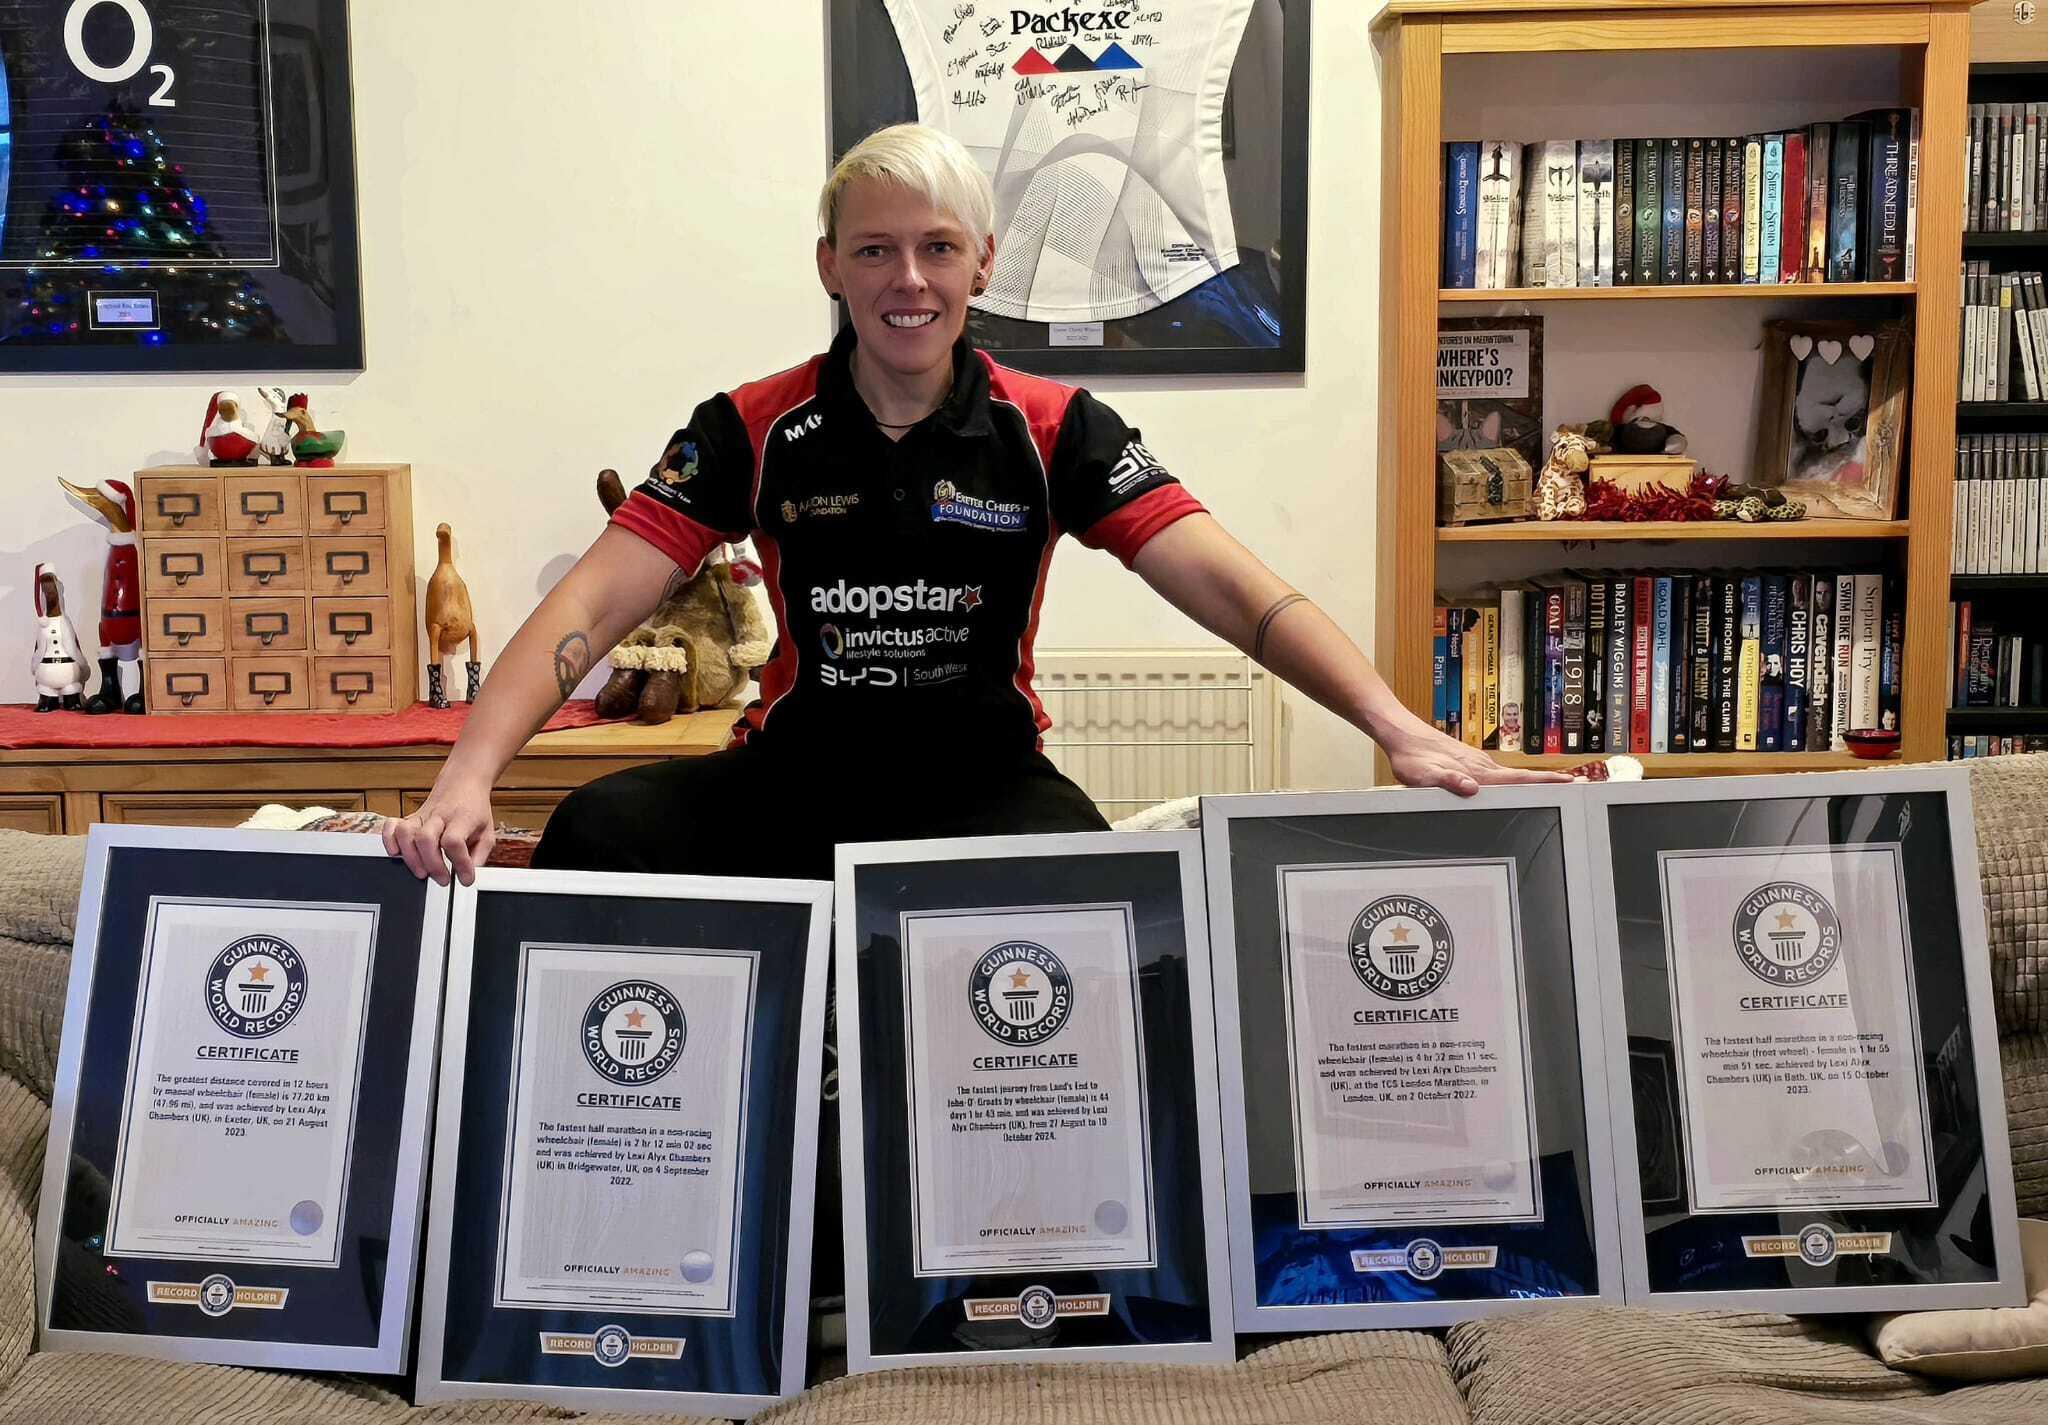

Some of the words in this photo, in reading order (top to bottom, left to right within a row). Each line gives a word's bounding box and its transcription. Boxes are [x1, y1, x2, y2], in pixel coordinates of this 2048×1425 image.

[1010, 7, 1131, 36] Packexe
[1766, 171, 1779, 200] SIEGE
[1883, 142, 1899, 244] THREADNEEDLE
[1766, 210, 1778, 248] STORM
[1437, 348, 1499, 366] WHERE'S
[940, 505, 1020, 524] FOUNDATION
[956, 492, 983, 508] EXETER
[986, 500, 1021, 512] CHIEFS
[810, 579, 962, 619] adopstar
[1657, 582, 1667, 618] ROALD
[1724, 584, 1733, 614] CHRIS
[1748, 583, 1755, 593] A
[1839, 582, 1852, 612] SWIM
[1549, 594, 1560, 634] GOAL
[1615, 583, 1625, 634] BRADLEY
[1747, 596, 1756, 617] LIFE
[1768, 585, 1777, 645] PENDLETON
[1776, 590, 1785, 640] VICTORIA
[1861, 586, 1878, 643] Stephen
[1657, 622, 1667, 651] DAHL
[1695, 612, 1709, 647] TROTT
[1723, 617, 1732, 661] FROOME
[1791, 611, 1806, 654] CHRIS
[1839, 615, 1851, 640] BIKE
[846, 649, 881, 659] lifestyle
[884, 649, 926, 659] solutions
[1450, 633, 1459, 658] Nepal
[1838, 644, 1851, 668] RUN
[1858, 647, 1876, 671] Fry
[1434, 656, 1445, 686] Paris
[1613, 637, 1625, 688] WIGGINS
[1746, 644, 1754, 687] WITHOUT
[1789, 658, 1804, 688] HOY
[1813, 614, 1829, 706] cavendish
[1968, 638, 1981, 693] Thesaurus
[1979, 637, 1993, 693] Dictionary
[820, 664, 898, 686] BYD
[1564, 655, 1582, 705] 1918
[1694, 662, 1708, 700] KENNY
[1722, 678, 1731, 698] THE
[1488, 683, 1496, 701] THE
[1745, 689, 1753, 720] LIMITS
[1613, 709, 1621, 724] MY
[1722, 701, 1731, 733] CLIMB
[1863, 712, 1869, 724] Me
[1362, 902, 1437, 929] GUINNESS
[1746, 888, 1824, 916] GUINNESS
[223, 942, 296, 969] GUINNESS
[982, 947, 1056, 976] GUINNESS
[1355, 943, 1391, 991] WORLD
[1398, 940, 1447, 994] RECORDS
[1739, 929, 1778, 977] WORLD
[1785, 926, 1834, 981] RECORDS
[211, 979, 240, 1028] WORLD
[245, 982, 301, 1032] RECORDS
[598, 987, 674, 1015] GUINNESS
[975, 989, 1011, 1037] WORLD
[1018, 985, 1067, 1040] RECORDS
[1740, 994, 1848, 1009] CERTIFICATE
[1353, 1008, 1459, 1022] CERTIFICATE
[197, 1046, 299, 1061] CERTIFICATE
[587, 1025, 619, 1075] WORLD
[624, 1028, 680, 1080] RECORDS
[973, 1054, 1078, 1069] CERTIFICATE
[577, 1093, 681, 1109] CERTIFICATE
[537, 1137, 584, 1145] wheelchair
[588, 1138, 621, 1147] (female)
[539, 1122, 554, 1131] The
[557, 1123, 585, 1132] fastest
[589, 1124, 604, 1133] half
[607, 1126, 647, 1135] marathon
[650, 1127, 657, 1135] in
[667, 1129, 712, 1139] non-racing
[537, 1161, 554, 1170] (UK)
[664, 1167, 709, 1176] September
[575, 1150, 612, 1159] achieved
[648, 1153, 665, 1162] Alyx
[669, 1154, 711, 1163] Chambers
[1754, 1166, 1811, 1175] OFFICIALLY
[1815, 1165, 1865, 1175] AMAZING
[1364, 1181, 1421, 1190] OFFICIALLY
[1424, 1179, 1472, 1188] AMAZING
[175, 1215, 230, 1225] OFFICIALLY
[233, 1218, 279, 1228] AMAZING
[979, 1227, 1036, 1237] OFFICIALLY
[1039, 1225, 1087, 1234] AMAZING
[1360, 1255, 1403, 1265] RECORD
[1443, 1252, 1486, 1262] HOLDER
[1753, 1241, 1796, 1251] RECORD
[1837, 1239, 1880, 1248] HOLDER
[564, 1264, 620, 1274] OFFICIALLY
[624, 1267, 671, 1277] AMAZING
[156, 1287, 197, 1297] RECORD
[236, 1292, 277, 1301] HOLDER
[975, 1305, 1017, 1313] RECORD
[1057, 1300, 1099, 1310] HOLDER
[550, 1338, 592, 1349] RECORD
[632, 1342, 674, 1352] HOLDER
